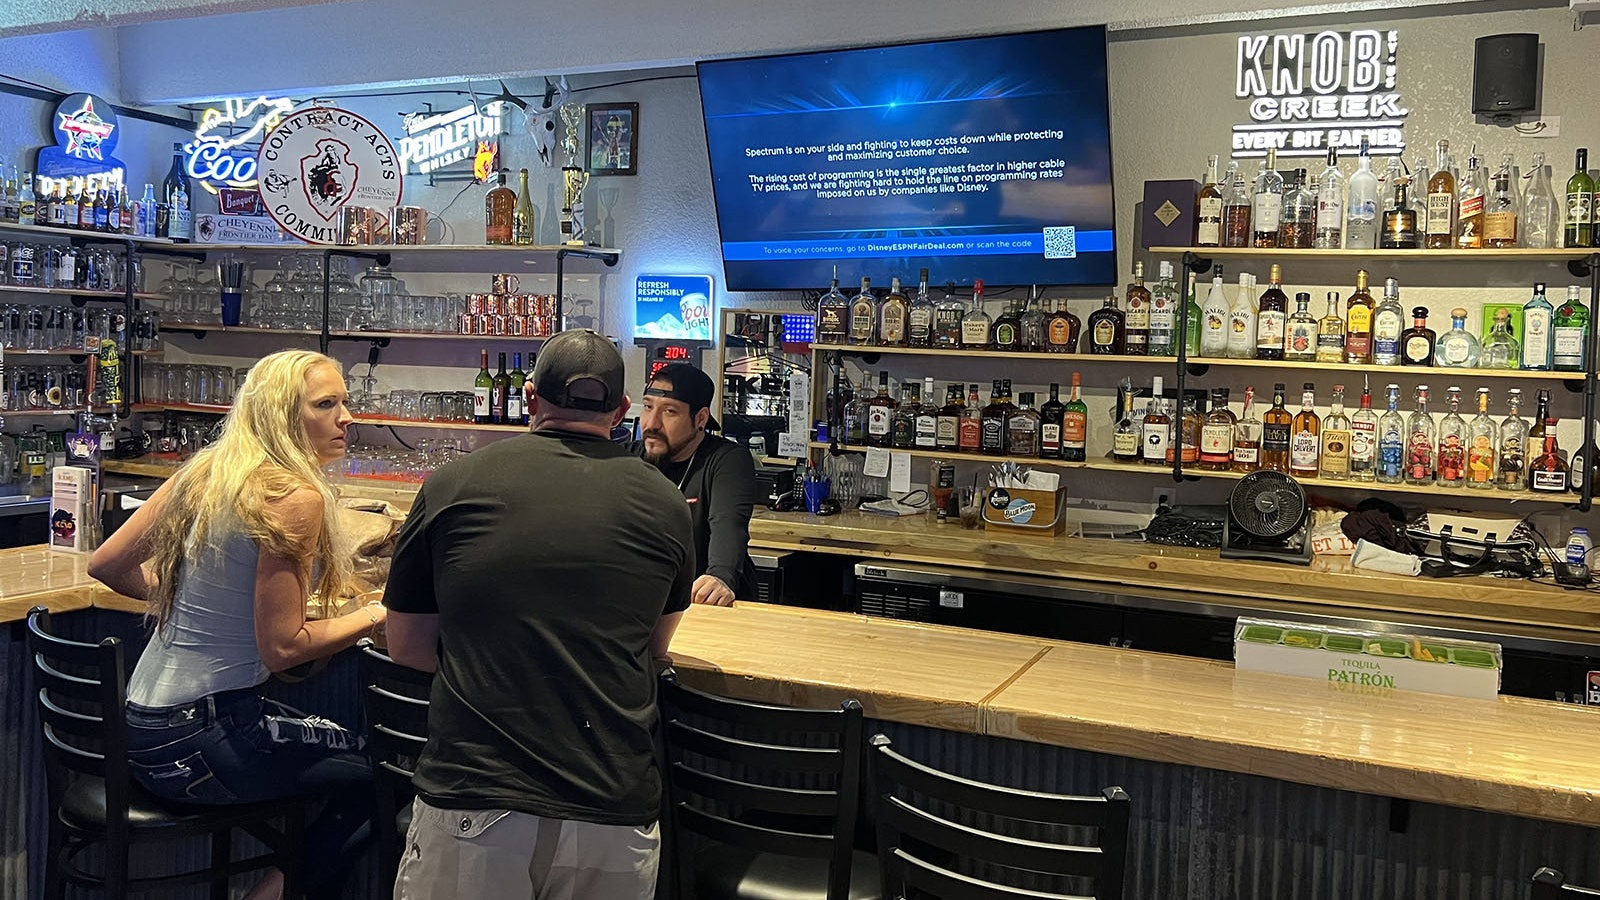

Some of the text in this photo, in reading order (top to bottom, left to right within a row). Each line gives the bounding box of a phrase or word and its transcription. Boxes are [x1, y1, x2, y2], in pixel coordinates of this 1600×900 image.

[1235, 29, 1382, 97] KNOB
[265, 113, 366, 161] CONTRACT
[363, 133, 396, 181] ACTS
[745, 148, 784, 157] Spectrum
[786, 146, 793, 155] is
[806, 145, 825, 155] your
[827, 143, 844, 152] side
[846, 142, 862, 150] and
[864, 140, 898, 151] fighting
[899, 140, 909, 148] to
[910, 138, 932, 148] keep
[934, 137, 958, 146] costs
[959, 135, 986, 143] down
[987, 132, 1012, 142] while
[1014, 129, 1064, 142] protecting
[1232, 131, 1289, 149] EVERY
[1292, 130, 1325, 148] BIT
[418, 146, 470, 175] WHISKY
[827, 145, 970, 161] and maximizing customer choice.
[184, 141, 259, 182] Coo
[748, 158, 1065, 184] The rising cost of programming is the single greatest factor in higher cable
[765, 182, 791, 192] prices,
[793, 181, 808, 189] and
[809, 182, 822, 190] we
[823, 181, 837, 189] are
[838, 179, 871, 189] fighting
[872, 178, 892, 187] hard
[894, 177, 904, 185] to
[905, 175, 925, 184] hold
[927, 174, 942, 184] the
[943, 173, 959, 183] line
[961, 174, 973, 182] on
[975, 170, 1037, 183] programming
[1039, 169, 1063, 178] rates
[816, 188, 852, 199] imposed
[853, 188, 865, 196] on
[878, 187, 889, 196] by
[891, 184, 938, 195] companies
[939, 182, 955, 192] like
[956, 182, 989, 193] Disney.
[226, 193, 254, 209] Banquet
[773, 246, 792, 254] voice
[793, 247, 809, 255] your
[846, 246, 856, 254] go
[867, 242, 964, 252] DisneyESPNFairDeal.com
[996, 240, 1010, 248] the
[637, 281, 670, 289] REFRESH
[637, 288, 685, 297] RESPONSIBLY
[938, 310, 955, 320] KNOB
[683, 316, 710, 332] LIGHT
[1326, 433, 1346, 441] Tito's
[1005, 504, 1035, 518] BLUE MOON
[1341, 658, 1381, 670] TEQUILA
[1327, 668, 1395, 689] PATRÓN
